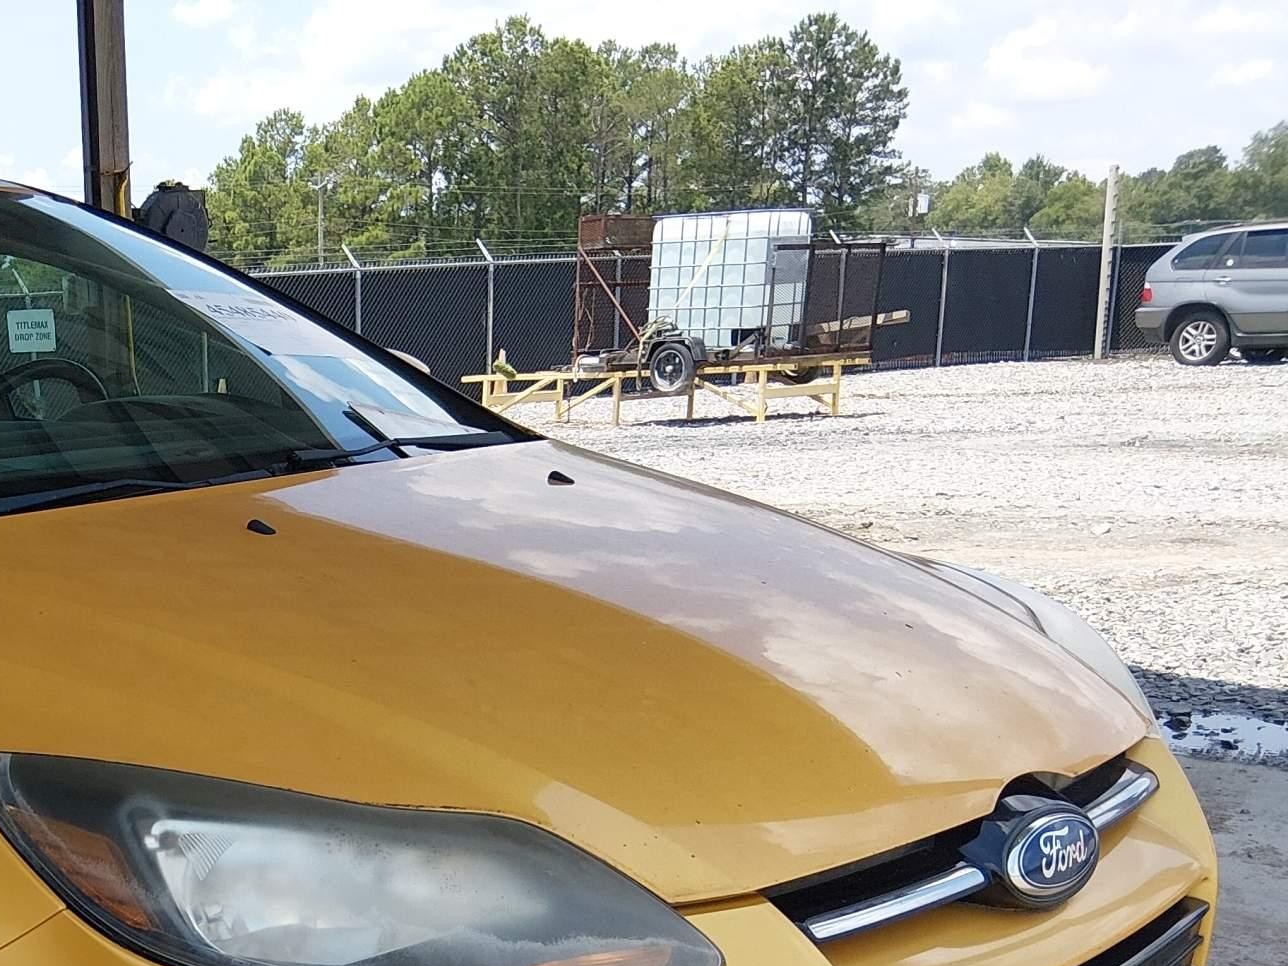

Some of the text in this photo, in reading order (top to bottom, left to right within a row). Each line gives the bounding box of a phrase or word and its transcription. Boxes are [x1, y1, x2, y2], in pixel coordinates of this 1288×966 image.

[15, 320, 49, 330] TITLEMAX
[14, 332, 52, 341] DROP ZONE
[1039, 825, 1088, 879] Ford
